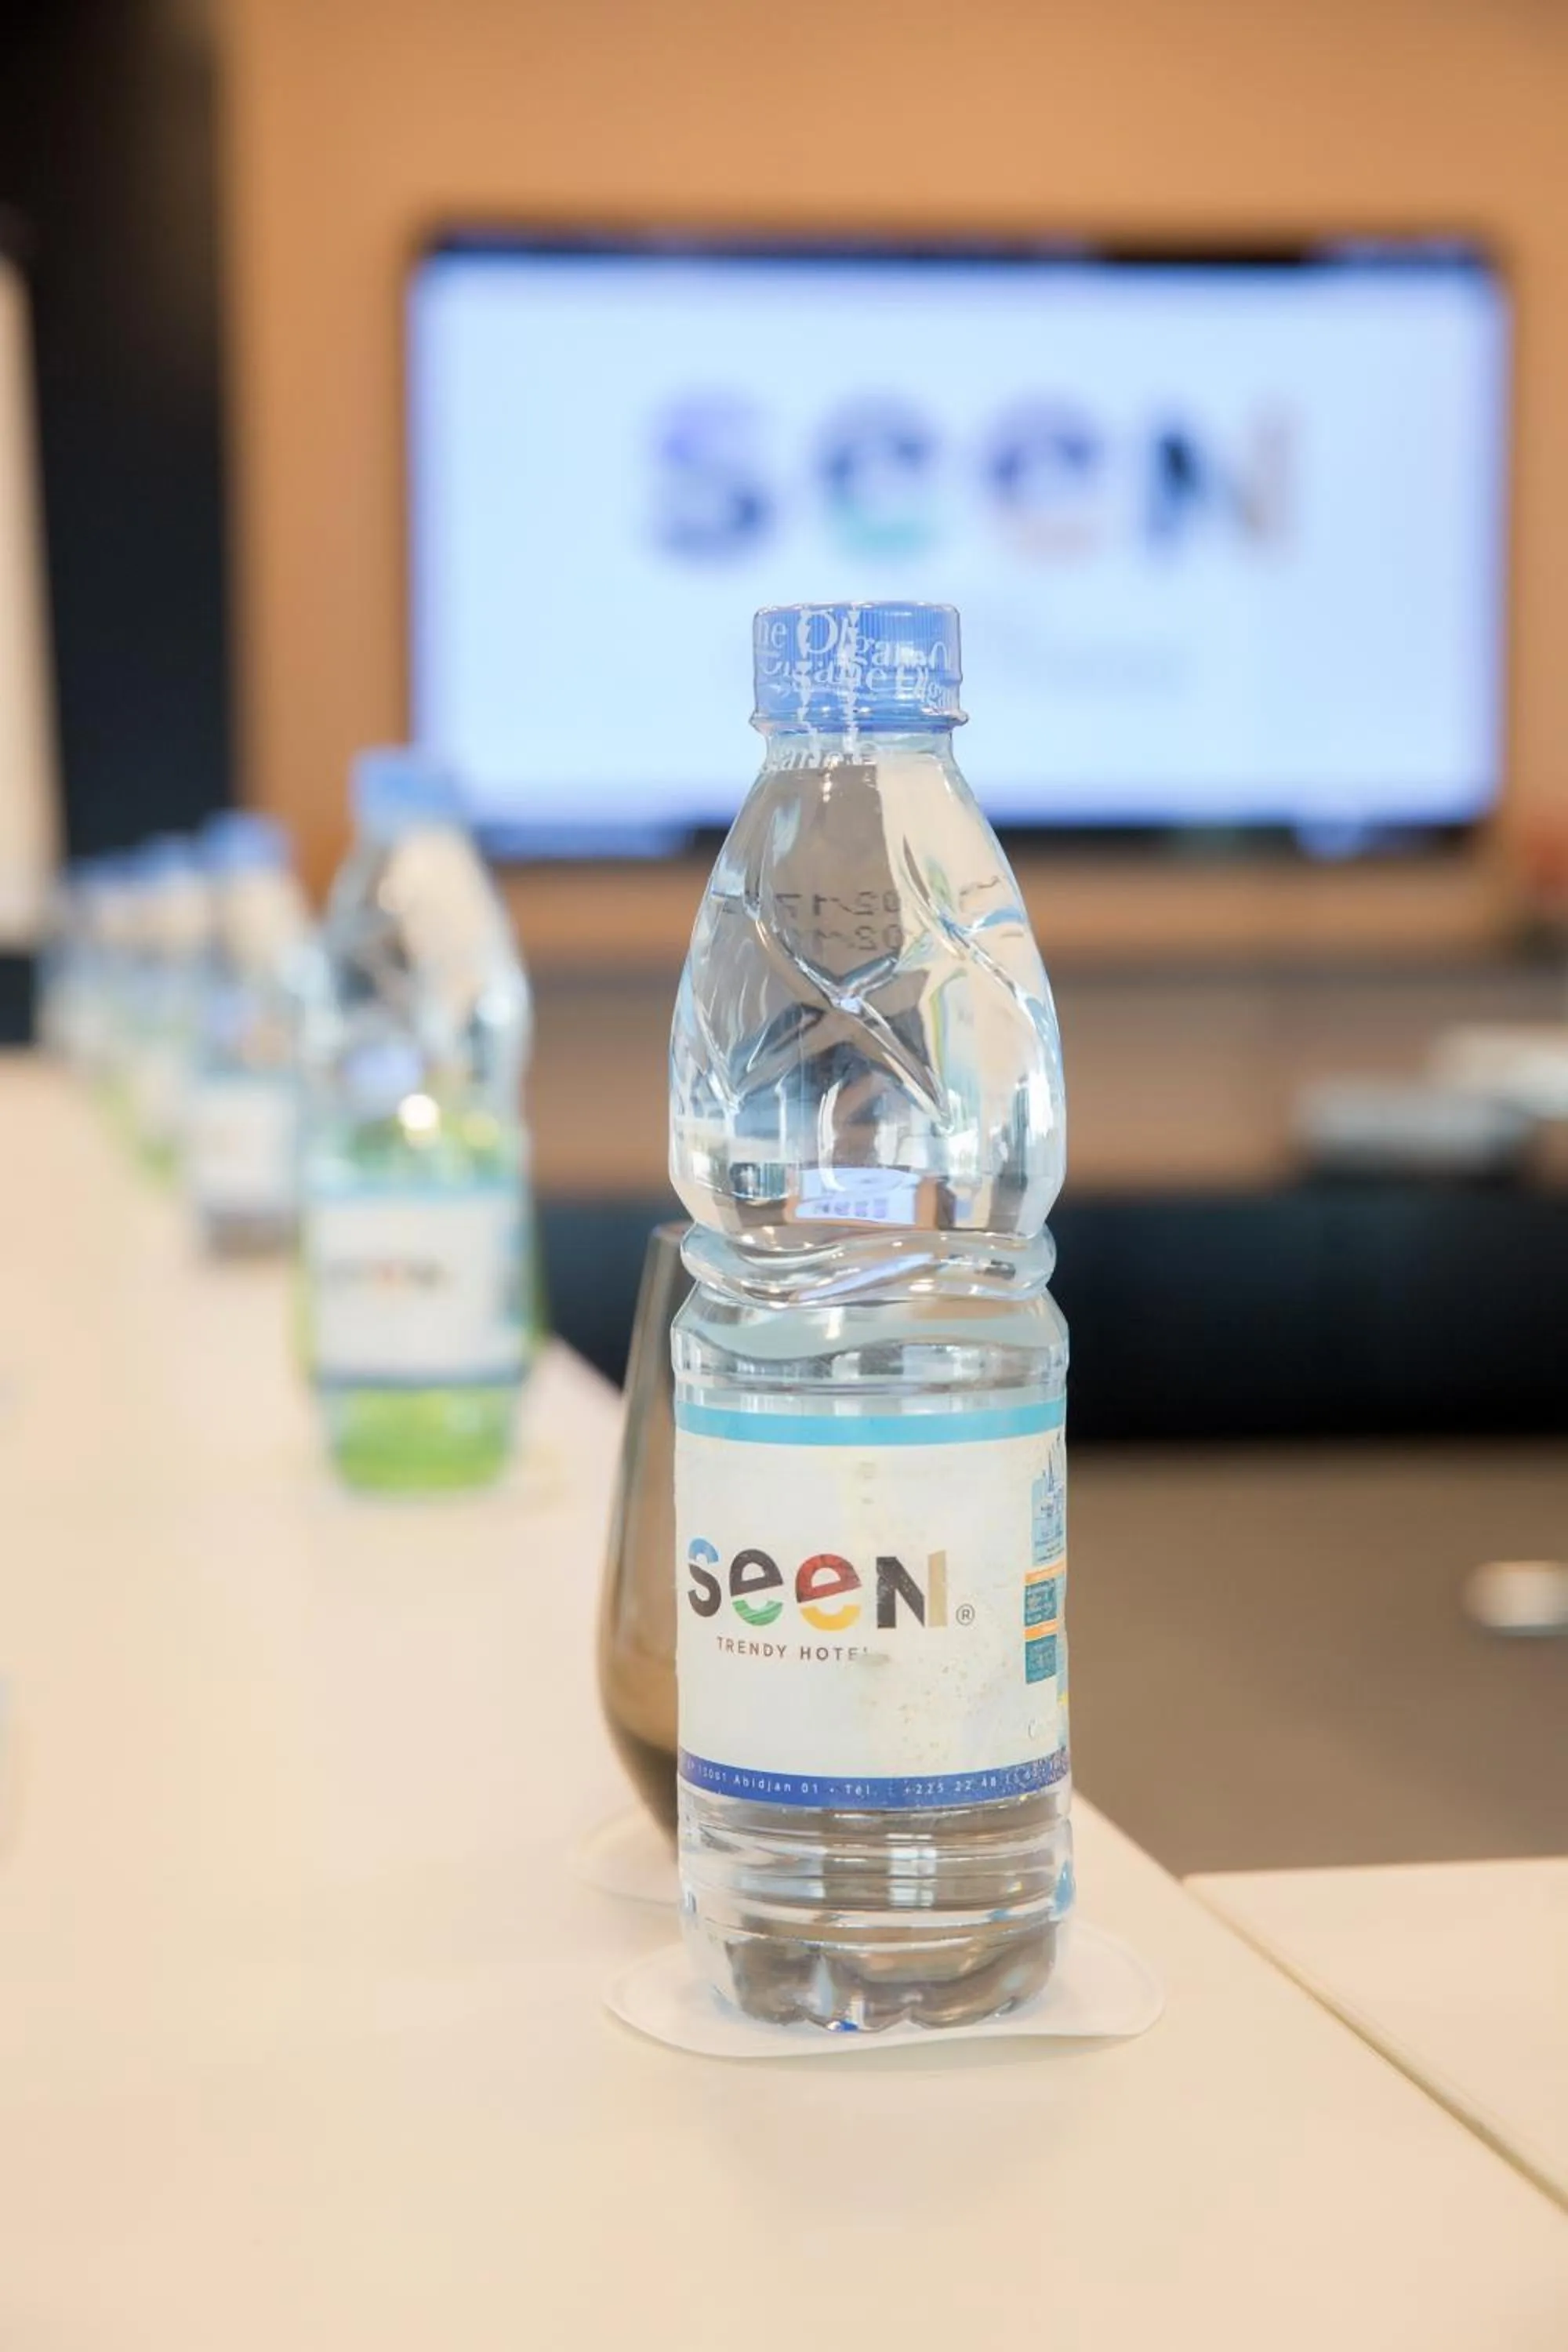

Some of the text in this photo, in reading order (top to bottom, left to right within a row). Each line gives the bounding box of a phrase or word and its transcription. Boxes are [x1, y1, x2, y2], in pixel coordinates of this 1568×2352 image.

[716, 1635, 870, 1661] TRENDY HOTE
[732, 1773, 792, 1794] Abidjan
[800, 1782, 819, 1795] 01
